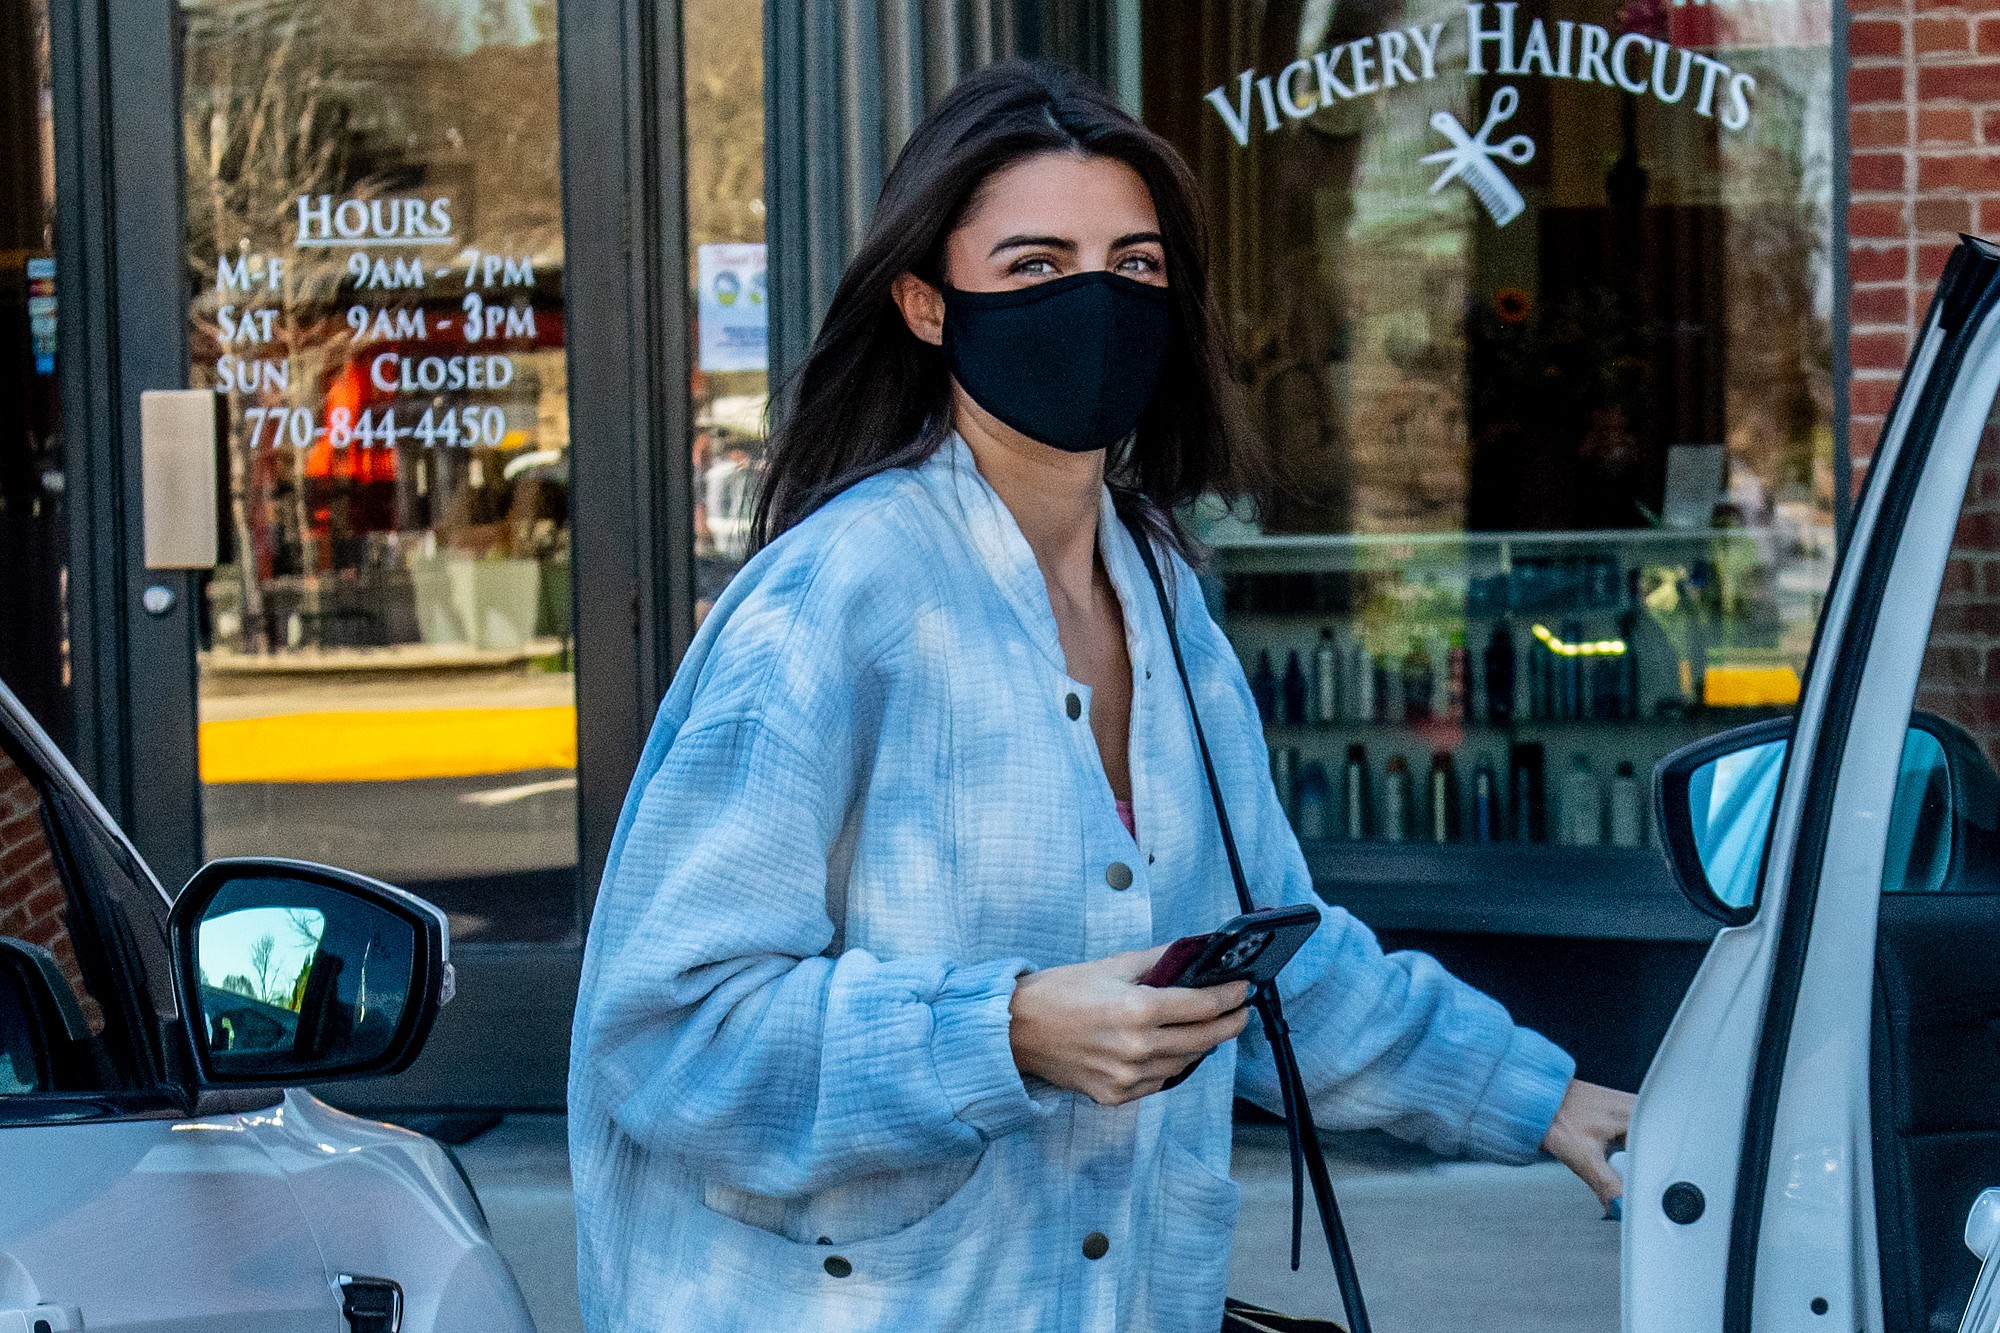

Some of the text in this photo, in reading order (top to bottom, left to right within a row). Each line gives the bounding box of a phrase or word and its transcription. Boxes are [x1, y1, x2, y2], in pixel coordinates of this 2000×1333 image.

[1203, 1, 1756, 147] VICKERY HAIRCUTS
[297, 194, 452, 238] HOURS
[216, 255, 284, 291] M-F
[348, 252, 425, 290] 9AM
[459, 246, 537, 289] 7PM
[216, 304, 278, 343] SAT
[346, 305, 427, 343] 9AM
[462, 291, 537, 343] 3PM
[215, 352, 514, 394] SUN CLOSED
[244, 405, 507, 449] 770-844-4450
